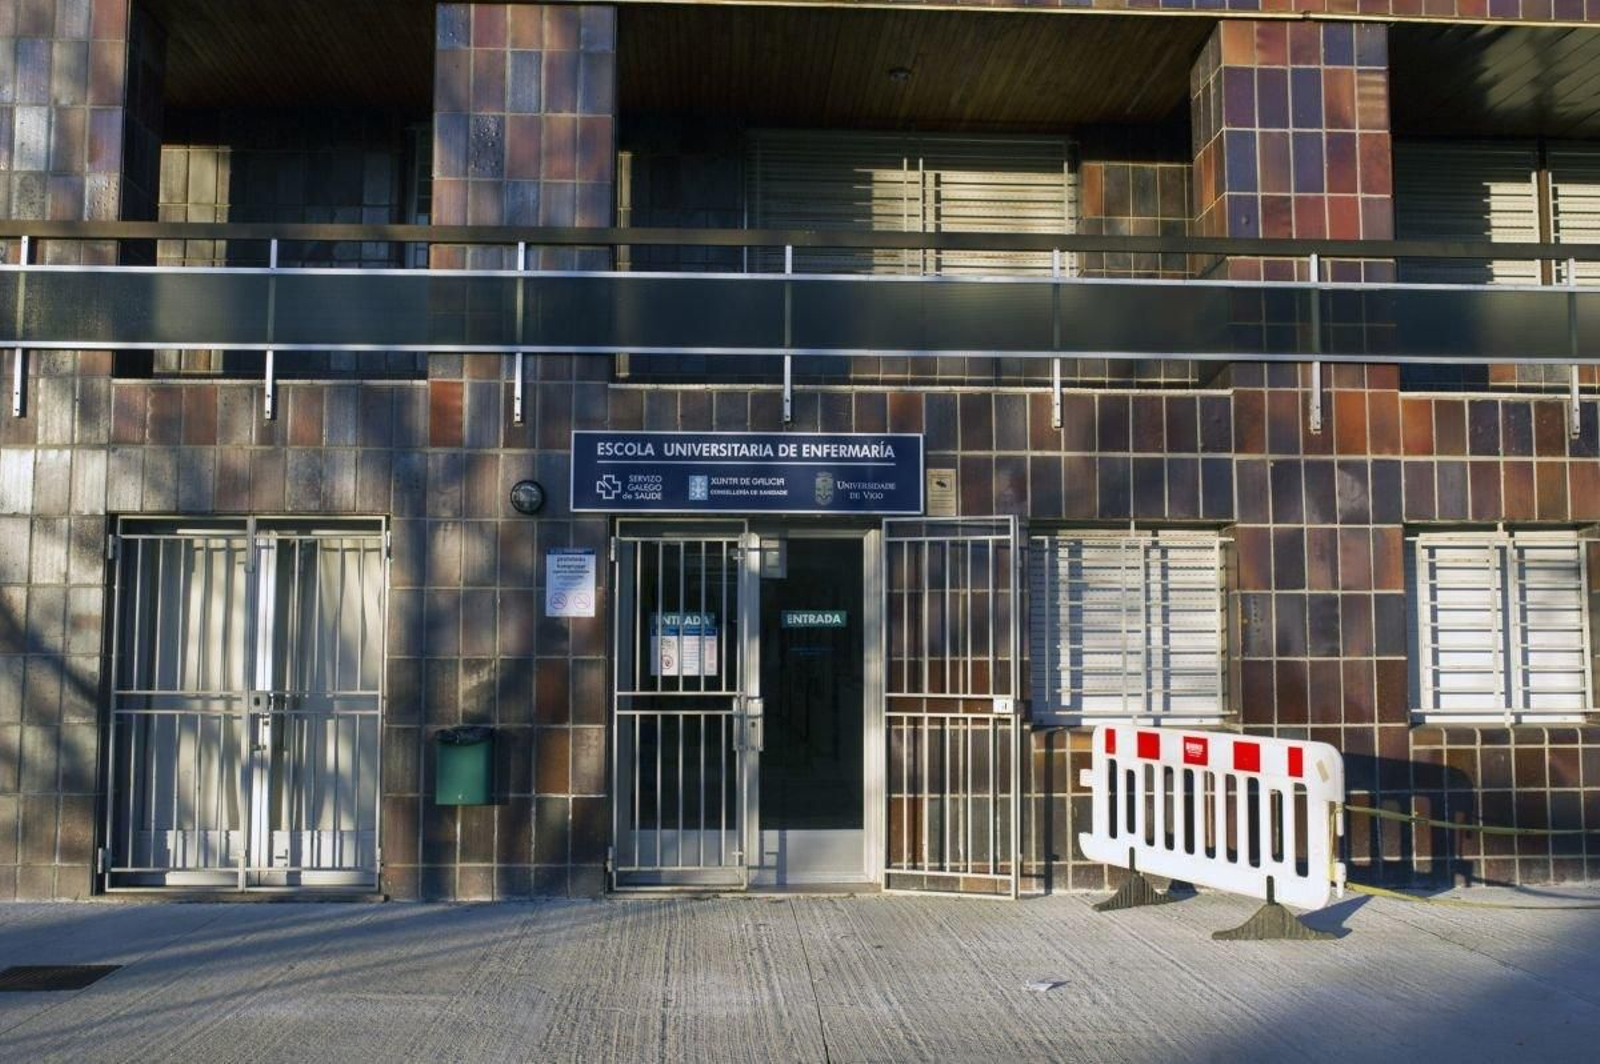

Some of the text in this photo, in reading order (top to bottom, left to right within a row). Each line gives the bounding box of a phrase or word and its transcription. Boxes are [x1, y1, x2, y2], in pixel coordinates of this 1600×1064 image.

[597, 440, 896, 458] ESCOLA UNIVERSITARIA DE ENFERMARÍA
[628, 475, 663, 483] SERVIZO
[710, 477, 785, 486] XUNTA DE GALICIA
[627, 483, 662, 491] GALEGO
[622, 491, 633, 500] de
[787, 613, 842, 624] ENTRADA
